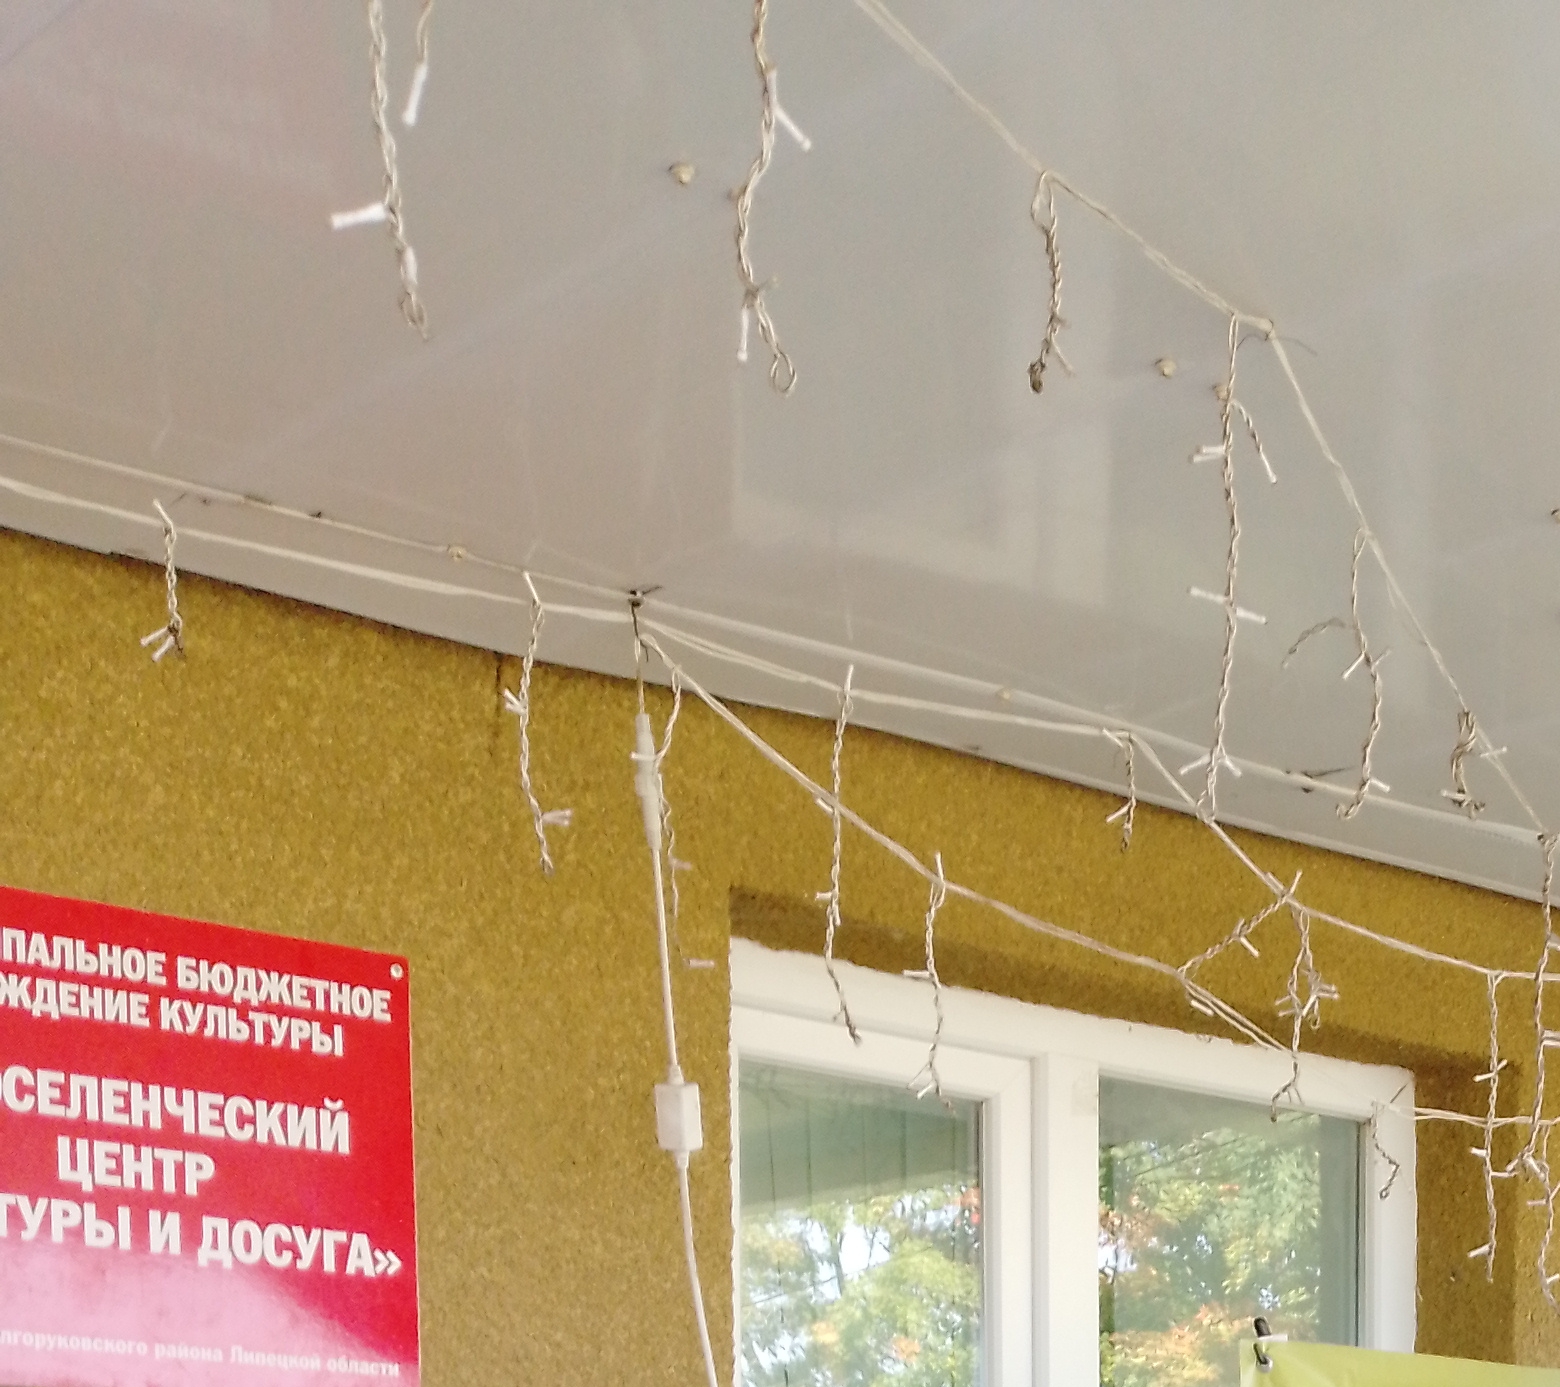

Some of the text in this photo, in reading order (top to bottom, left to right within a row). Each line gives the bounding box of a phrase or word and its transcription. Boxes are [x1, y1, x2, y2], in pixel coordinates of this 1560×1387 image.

[2, 926, 391, 1023] ПАЛЬНОЕ БЮДЖЕТНОЕ
[0, 971, 344, 1056] ЖДЕНИЕ КУЛЬТУРЫ
[0, 1065, 350, 1154] СЕЛЕНЧЕСКИЙ
[57, 1136, 215, 1195] ЦЕНТР
[149, 1210, 181, 1255] И
[199, 1215, 402, 1277] ДОСУГА»
[154, 1337, 223, 1362] района
[229, 1345, 320, 1371] Липецкой
[327, 1357, 400, 1377] области
